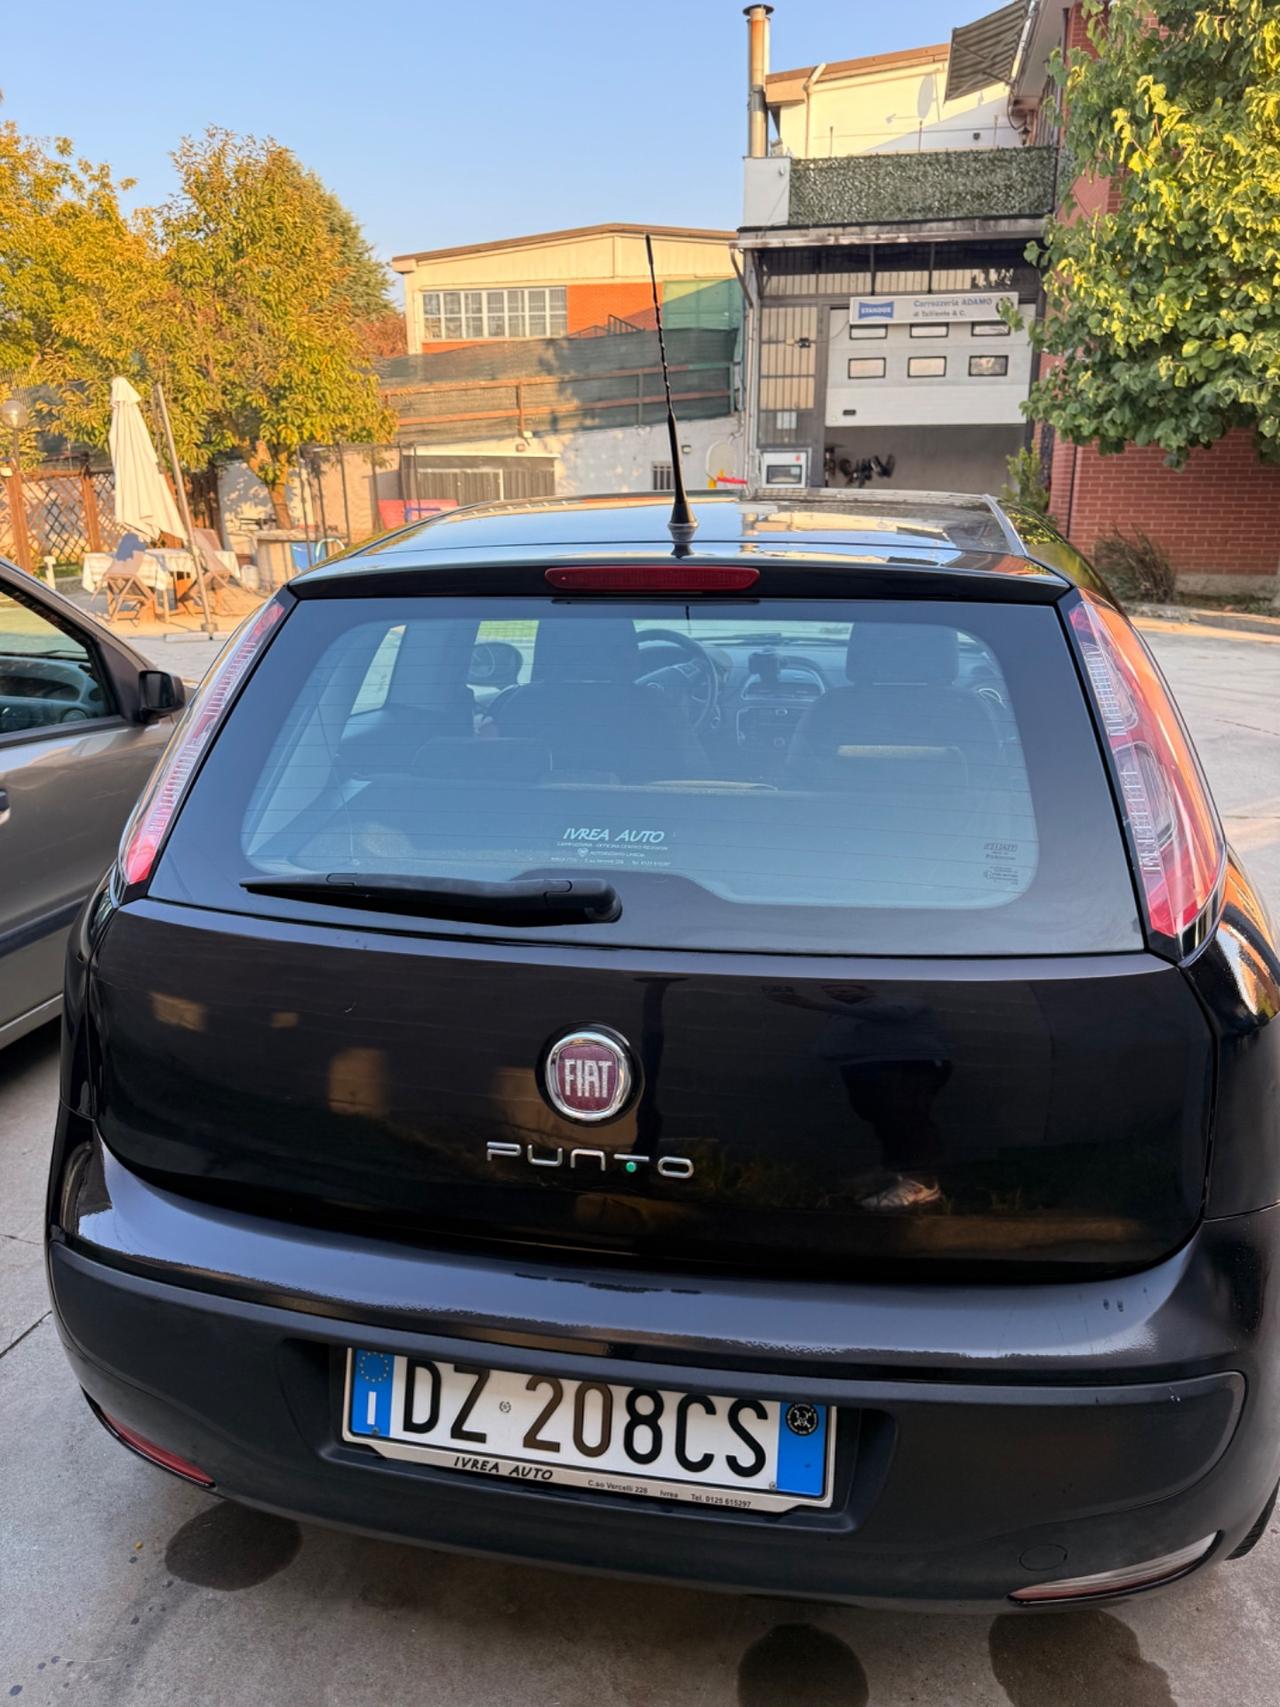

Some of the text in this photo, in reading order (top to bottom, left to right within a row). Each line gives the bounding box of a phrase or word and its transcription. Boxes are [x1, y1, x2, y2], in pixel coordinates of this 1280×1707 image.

[961, 296, 993, 306] ADAMO
[563, 828, 665, 843] IVREA AUTO
[564, 1058, 613, 1098] FIAT
[486, 1141, 695, 1179] PUNTO
[403, 1357, 768, 1478] DZ 208CS
[453, 1456, 553, 1480] IVREA AUTO
[606, 1482, 634, 1493] Vercelli
[659, 1490, 679, 1499] Ivrea
[690, 1493, 704, 1502] Tel.
[705, 1495, 723, 1504] 0125
